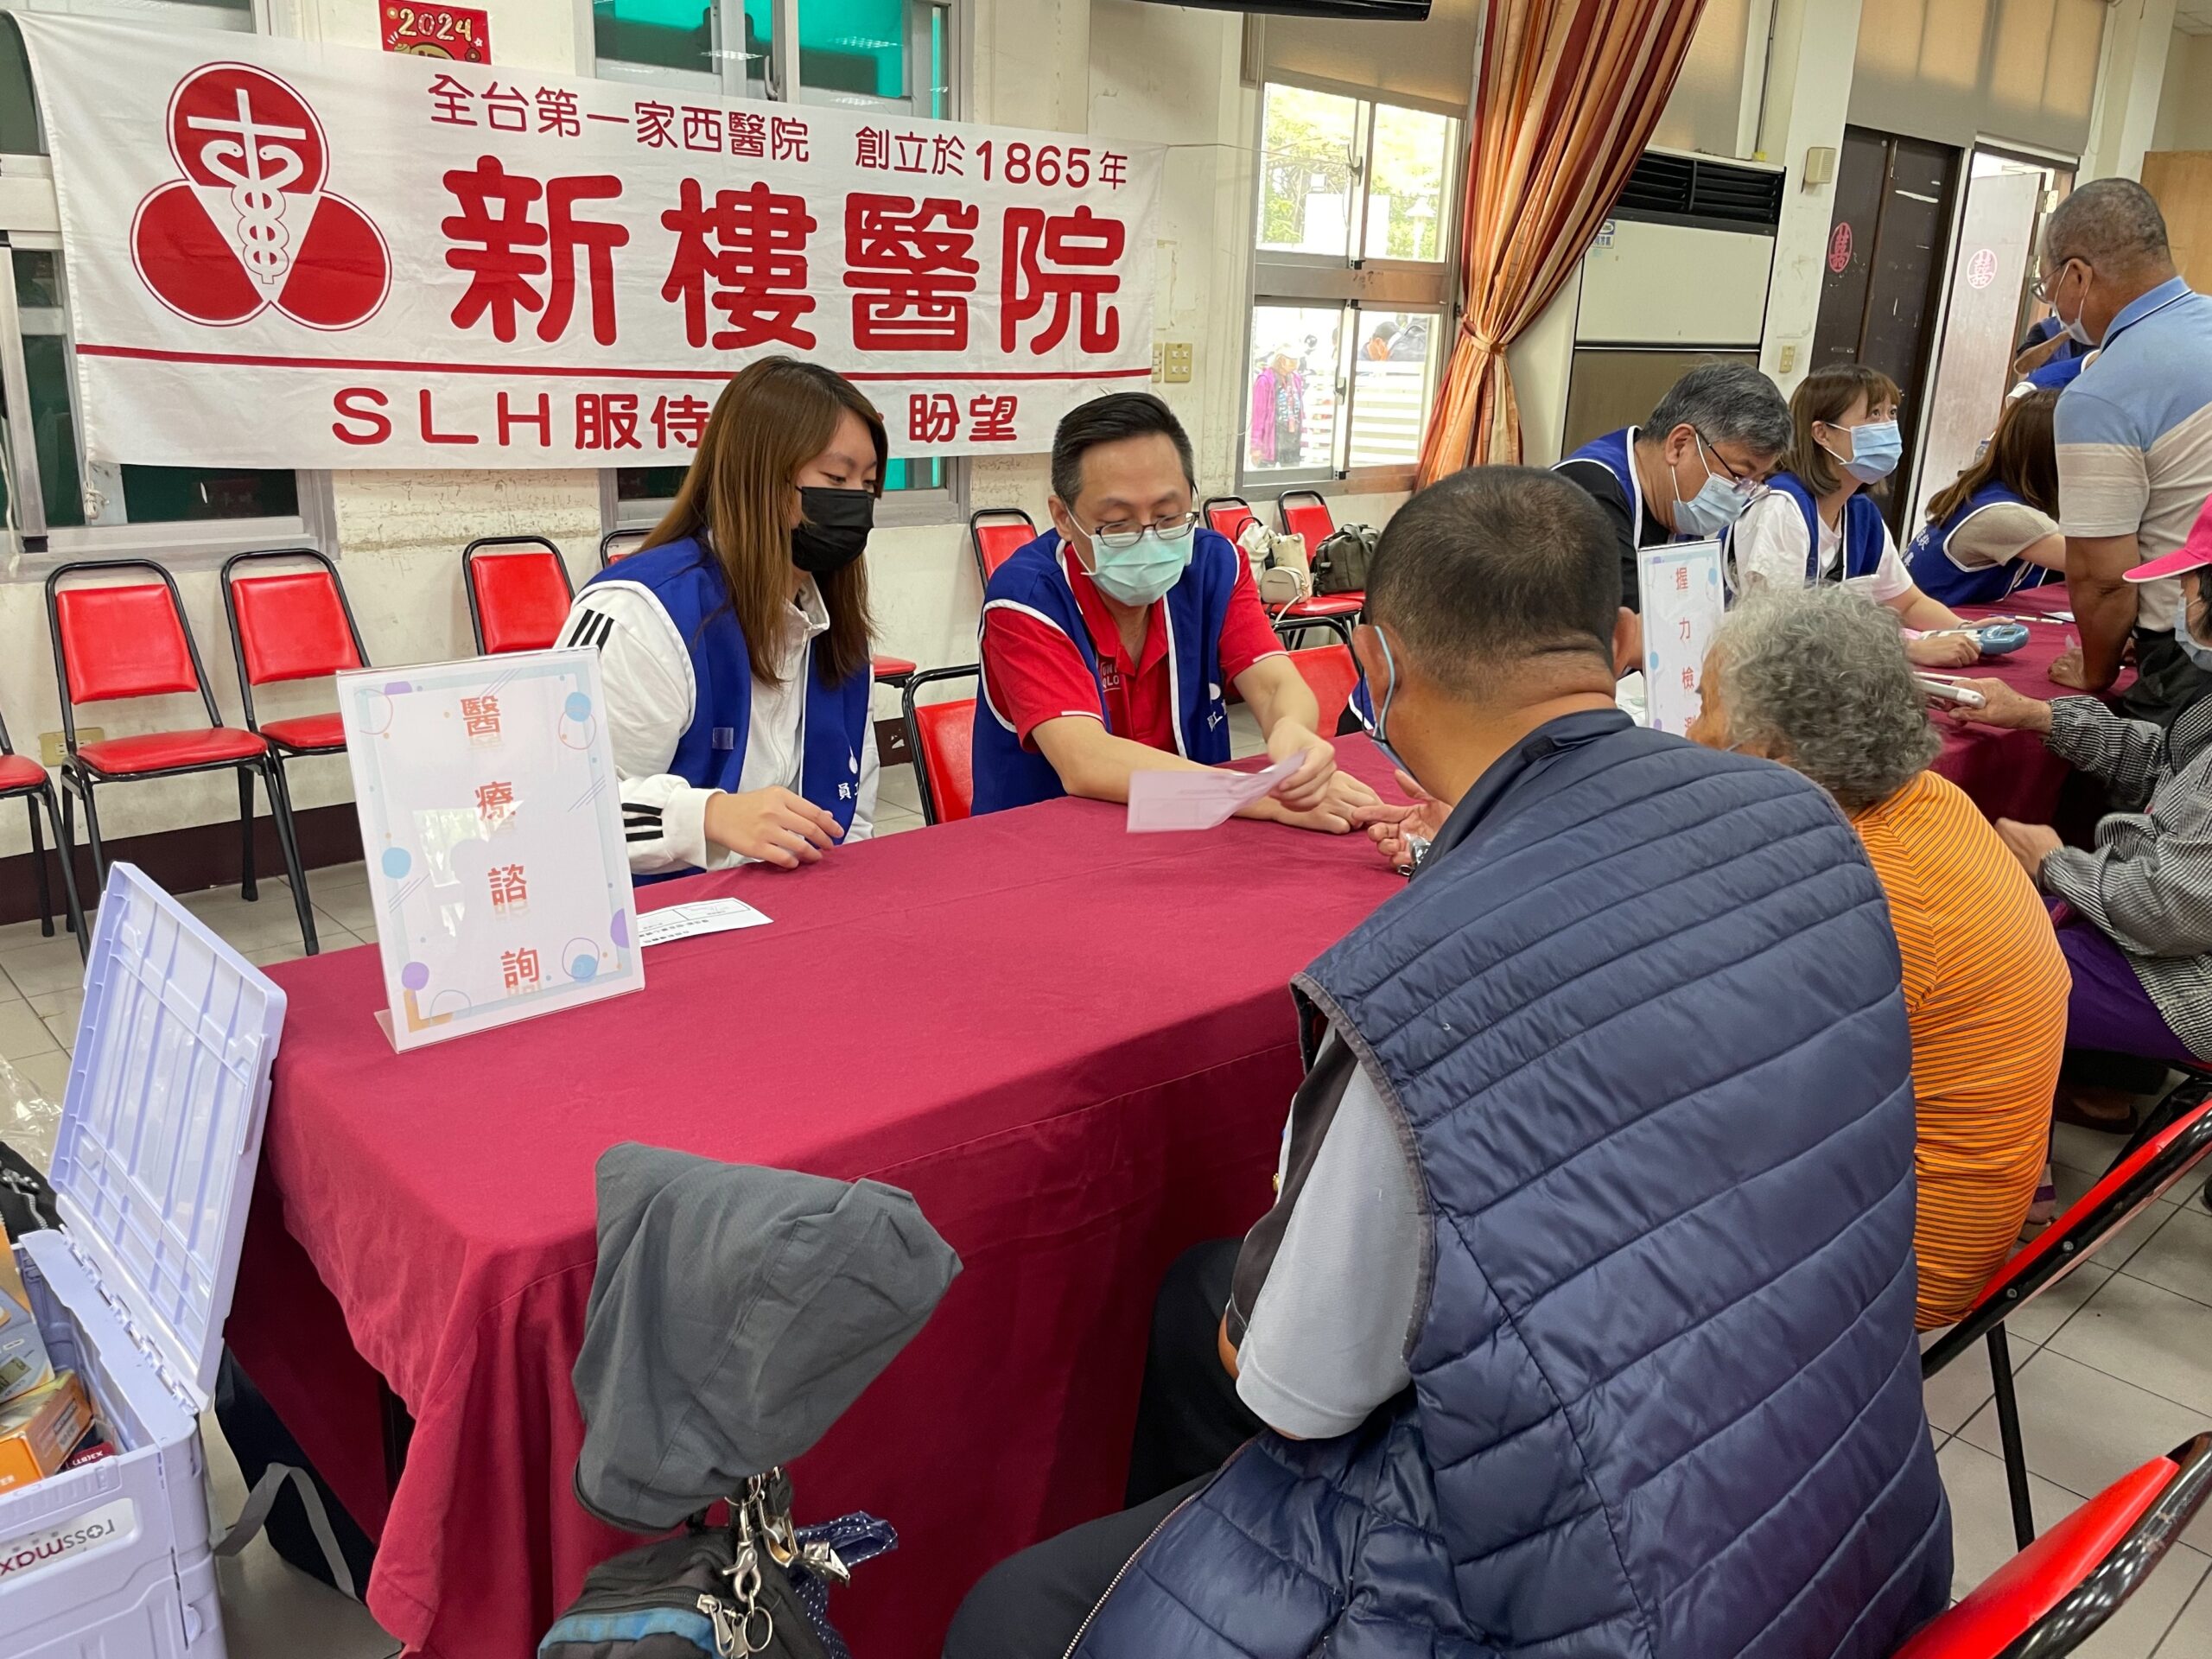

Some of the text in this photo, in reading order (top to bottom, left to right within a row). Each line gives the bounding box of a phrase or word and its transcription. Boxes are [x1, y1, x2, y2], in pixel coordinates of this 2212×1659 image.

[397, 8, 473, 42] 2024
[428, 73, 1128, 190] 全台第一家西醫院 創立於1865年
[441, 155, 1126, 355] 新樓醫院
[460, 695, 540, 988] 醫療諮詢
[0, 1519, 115, 1576] rossmax
